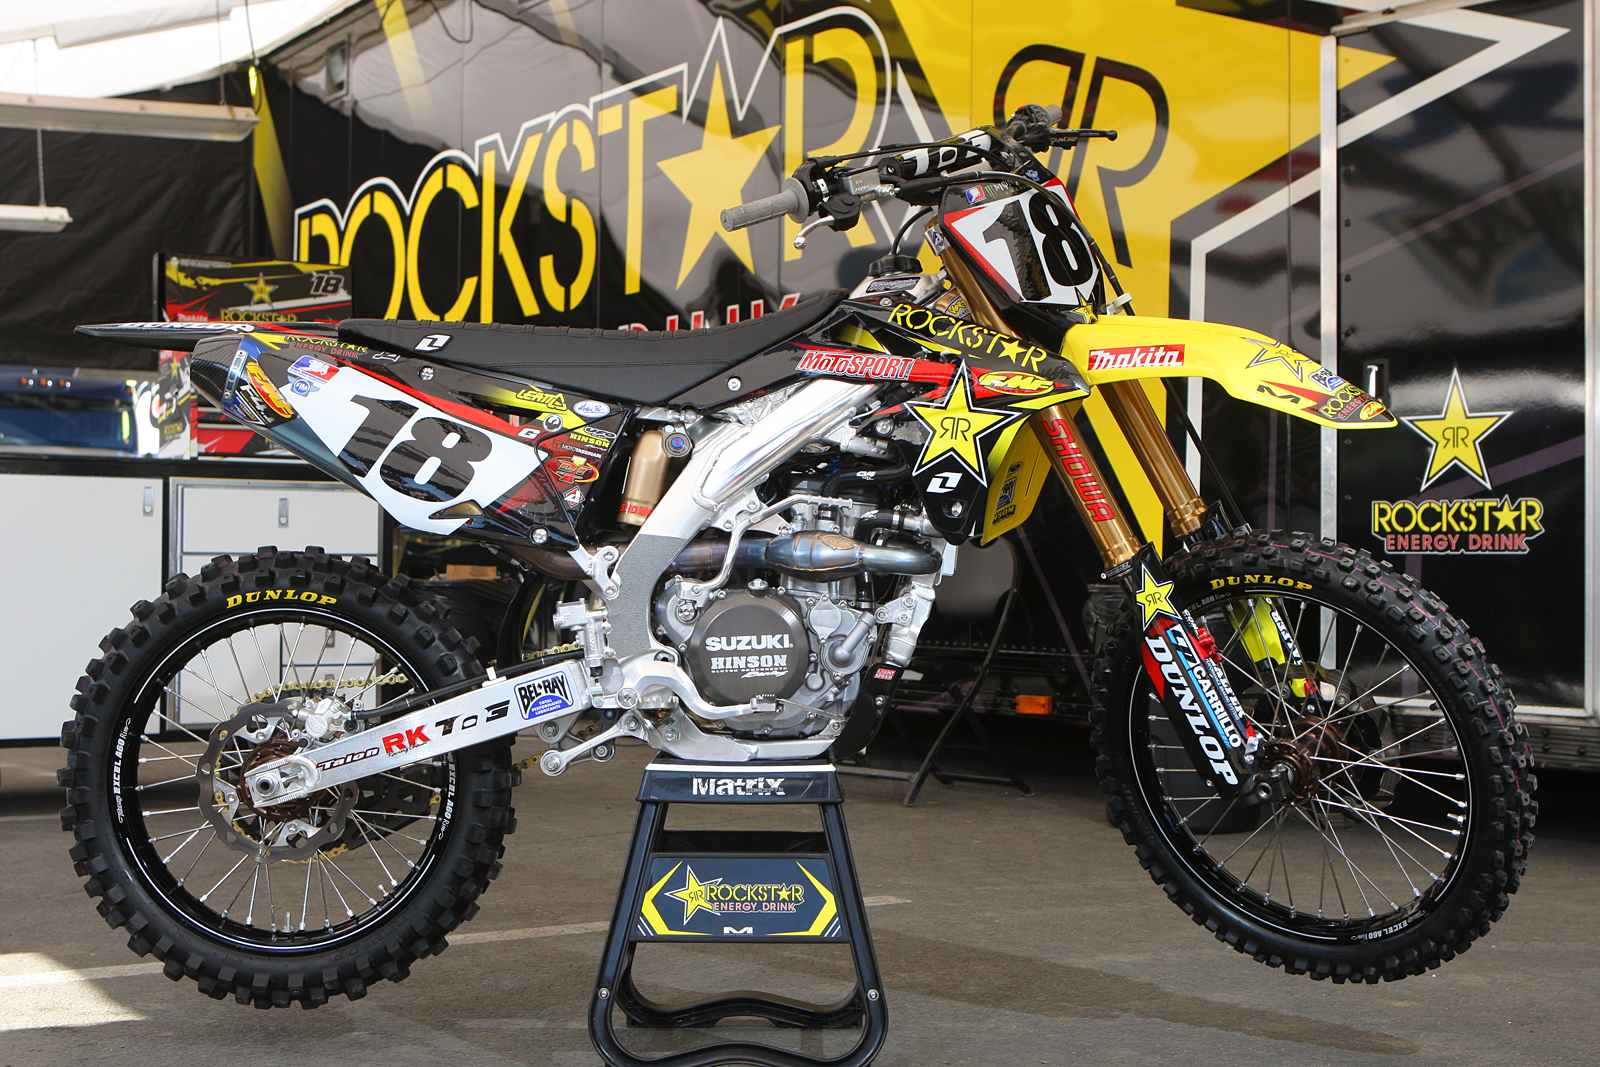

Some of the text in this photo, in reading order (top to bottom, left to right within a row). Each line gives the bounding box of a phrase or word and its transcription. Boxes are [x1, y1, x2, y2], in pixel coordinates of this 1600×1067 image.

[982, 187, 1093, 301] 18
[311, 274, 344, 296] 18
[290, 341, 359, 359] ENERGY DRINK
[245, 361, 294, 415] FMF
[979, 374, 1054, 391] FMF
[350, 394, 493, 503] 18
[569, 433, 611, 449] HINSON
[1041, 418, 1116, 523] SHOWA
[1373, 500, 1543, 533] ROCKSTAR
[1386, 533, 1527, 550] ENERGY DRINK
[1210, 574, 1313, 591] DUNLOP
[226, 589, 338, 609] DUNLOP
[705, 634, 790, 652] SUZUKI
[711, 654, 788, 670] HINSON
[1144, 636, 1239, 786] DUNLOP
[1194, 666, 1242, 749] CARRILLO
[115, 739, 125, 759] A60
[382, 725, 431, 754] RK
[317, 747, 379, 770] Talon
[113, 760, 122, 794] EXCEL
[448, 763, 456, 798] EXCEL
[692, 777, 786, 796] Matrix
[444, 799, 454, 820] A60
[706, 885, 804, 901] ROCKSTAR
[713, 902, 795, 911] ENERGY DRINK
[1368, 930, 1383, 940] A60
[1383, 919, 1408, 935] EXCEL
